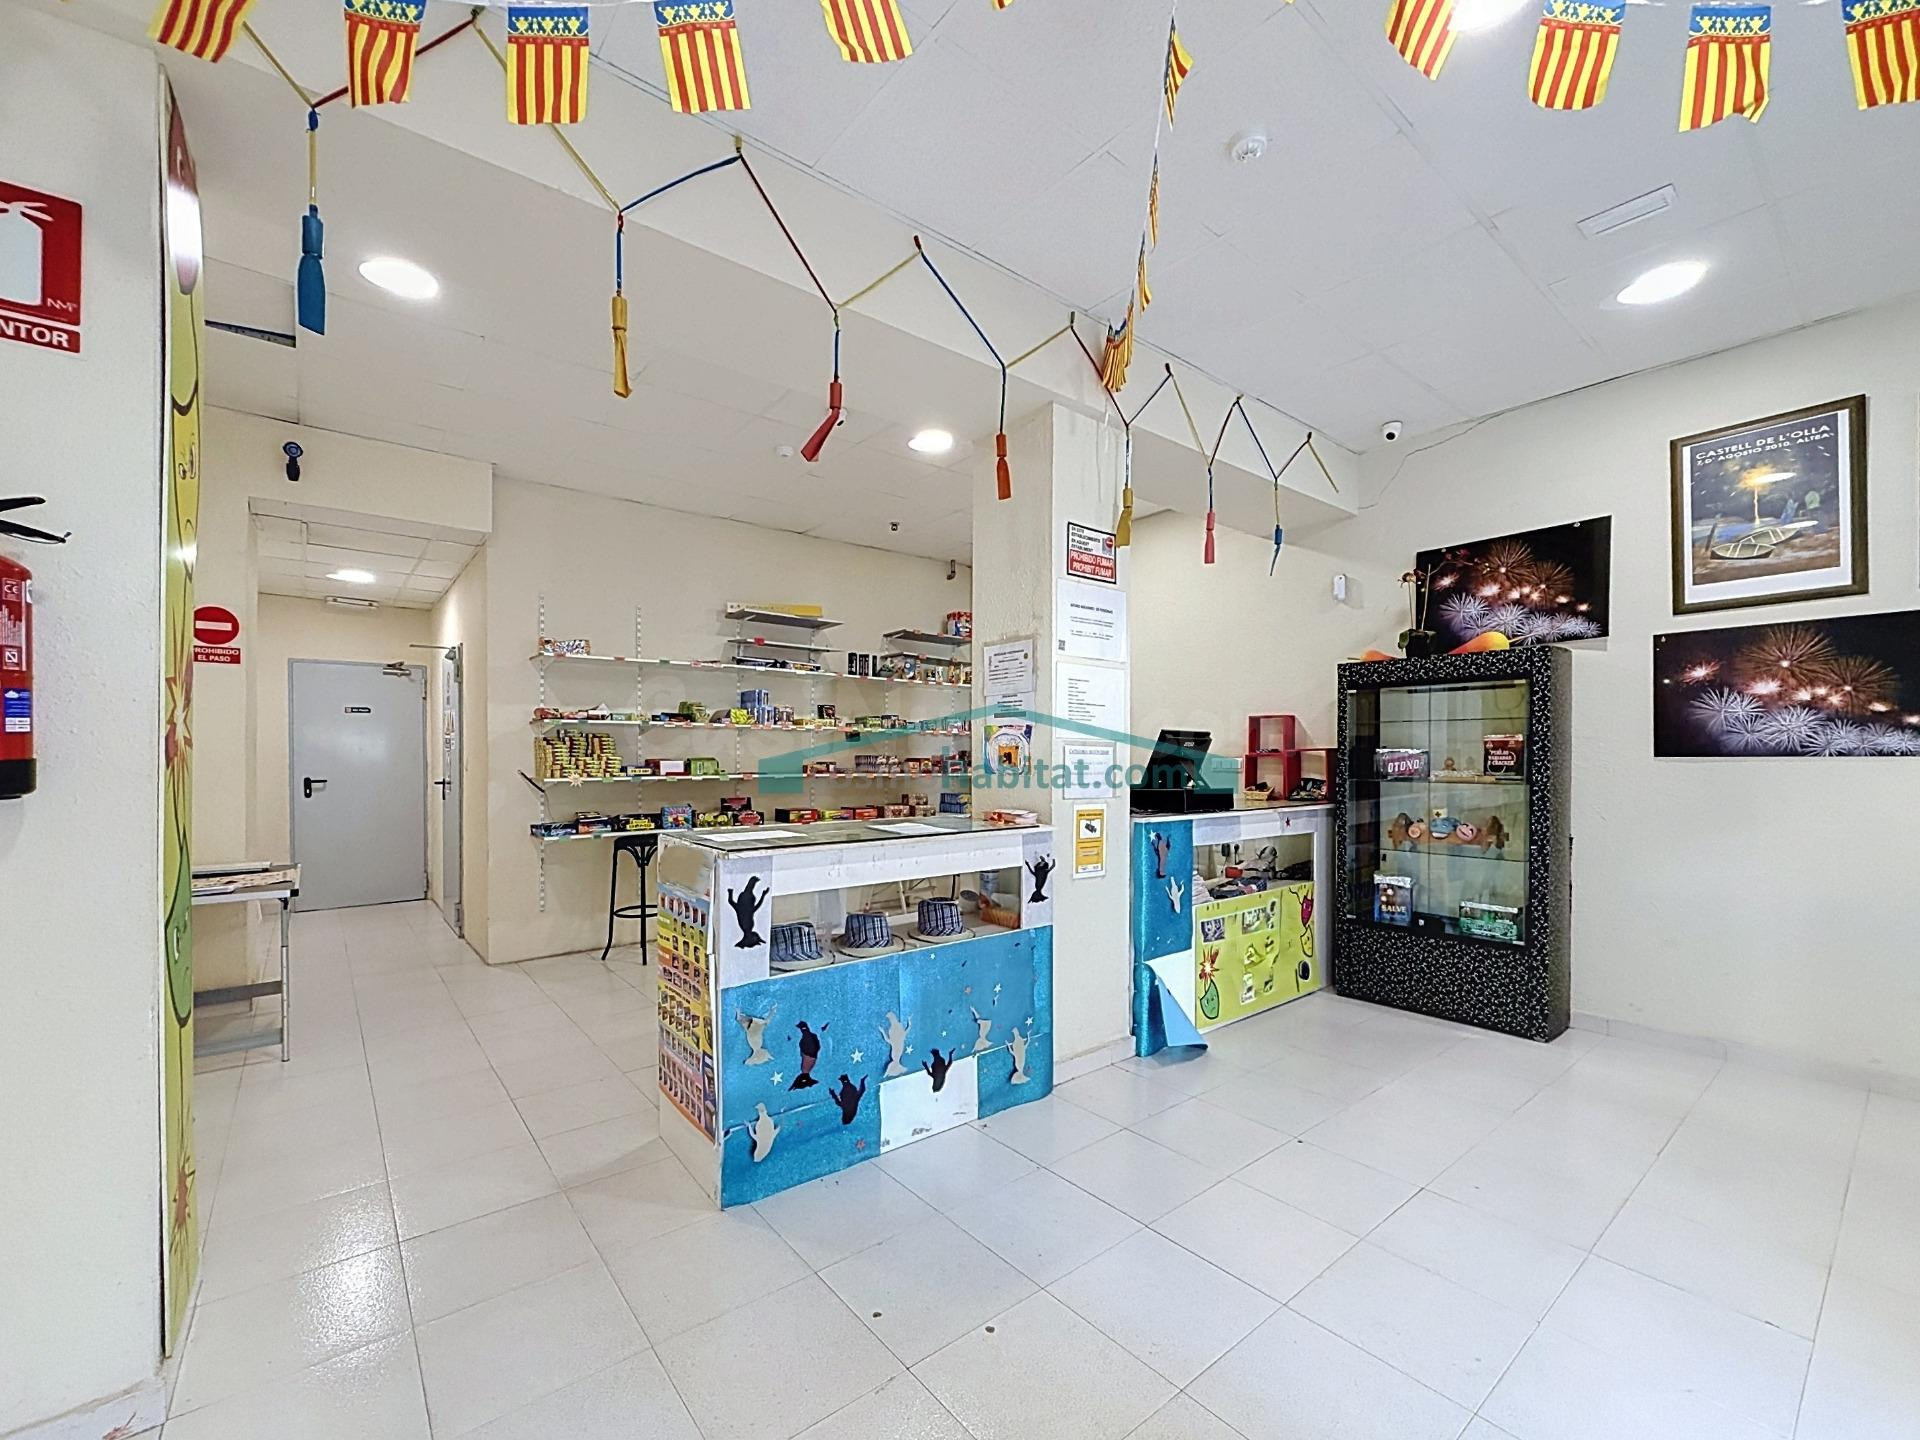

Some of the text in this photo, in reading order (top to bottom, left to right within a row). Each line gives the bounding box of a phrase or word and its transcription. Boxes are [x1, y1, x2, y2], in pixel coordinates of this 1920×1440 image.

[1695, 425, 1831, 460] CASTELL DE L'OLLA
[1070, 551, 1114, 569] PROHIBIDO FUMAR
[1072, 561, 1113, 577] PROHIBIT FUMAR
[194, 647, 240, 655] ROHIBIDO
[1381, 904, 1407, 913] SALVE
